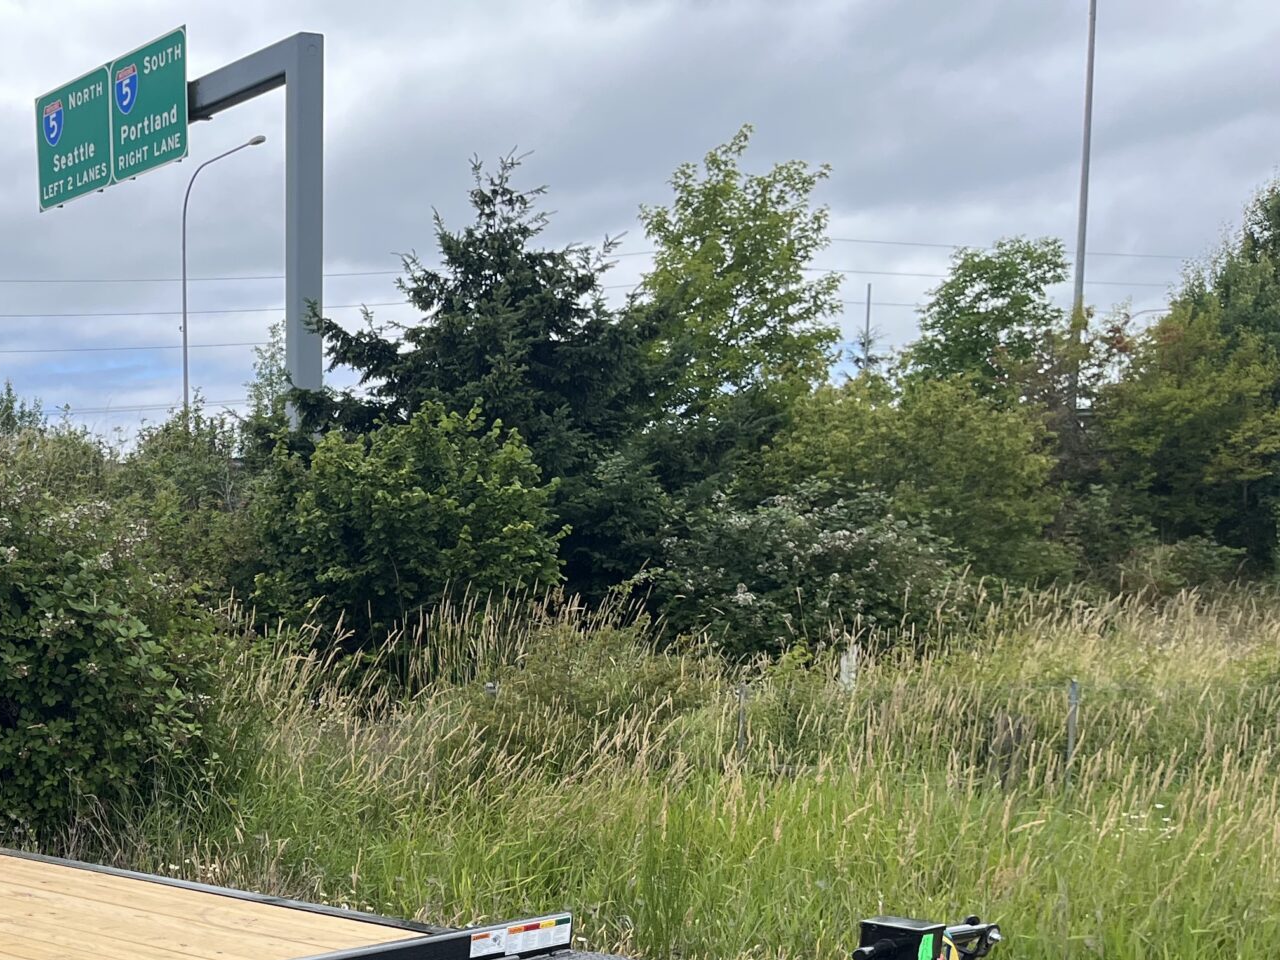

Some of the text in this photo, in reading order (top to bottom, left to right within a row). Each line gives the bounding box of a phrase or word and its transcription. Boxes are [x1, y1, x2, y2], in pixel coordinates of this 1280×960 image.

[143, 43, 182, 74] SOUTH
[68, 82, 103, 110] NORTH
[122, 78, 131, 106] 5
[49, 113, 58, 138] 5
[121, 103, 177, 145] Portland
[53, 142, 95, 172] Seattle
[118, 132, 181, 170] RIGHT LANE
[43, 162, 107, 200] LEFT 2 LANES
